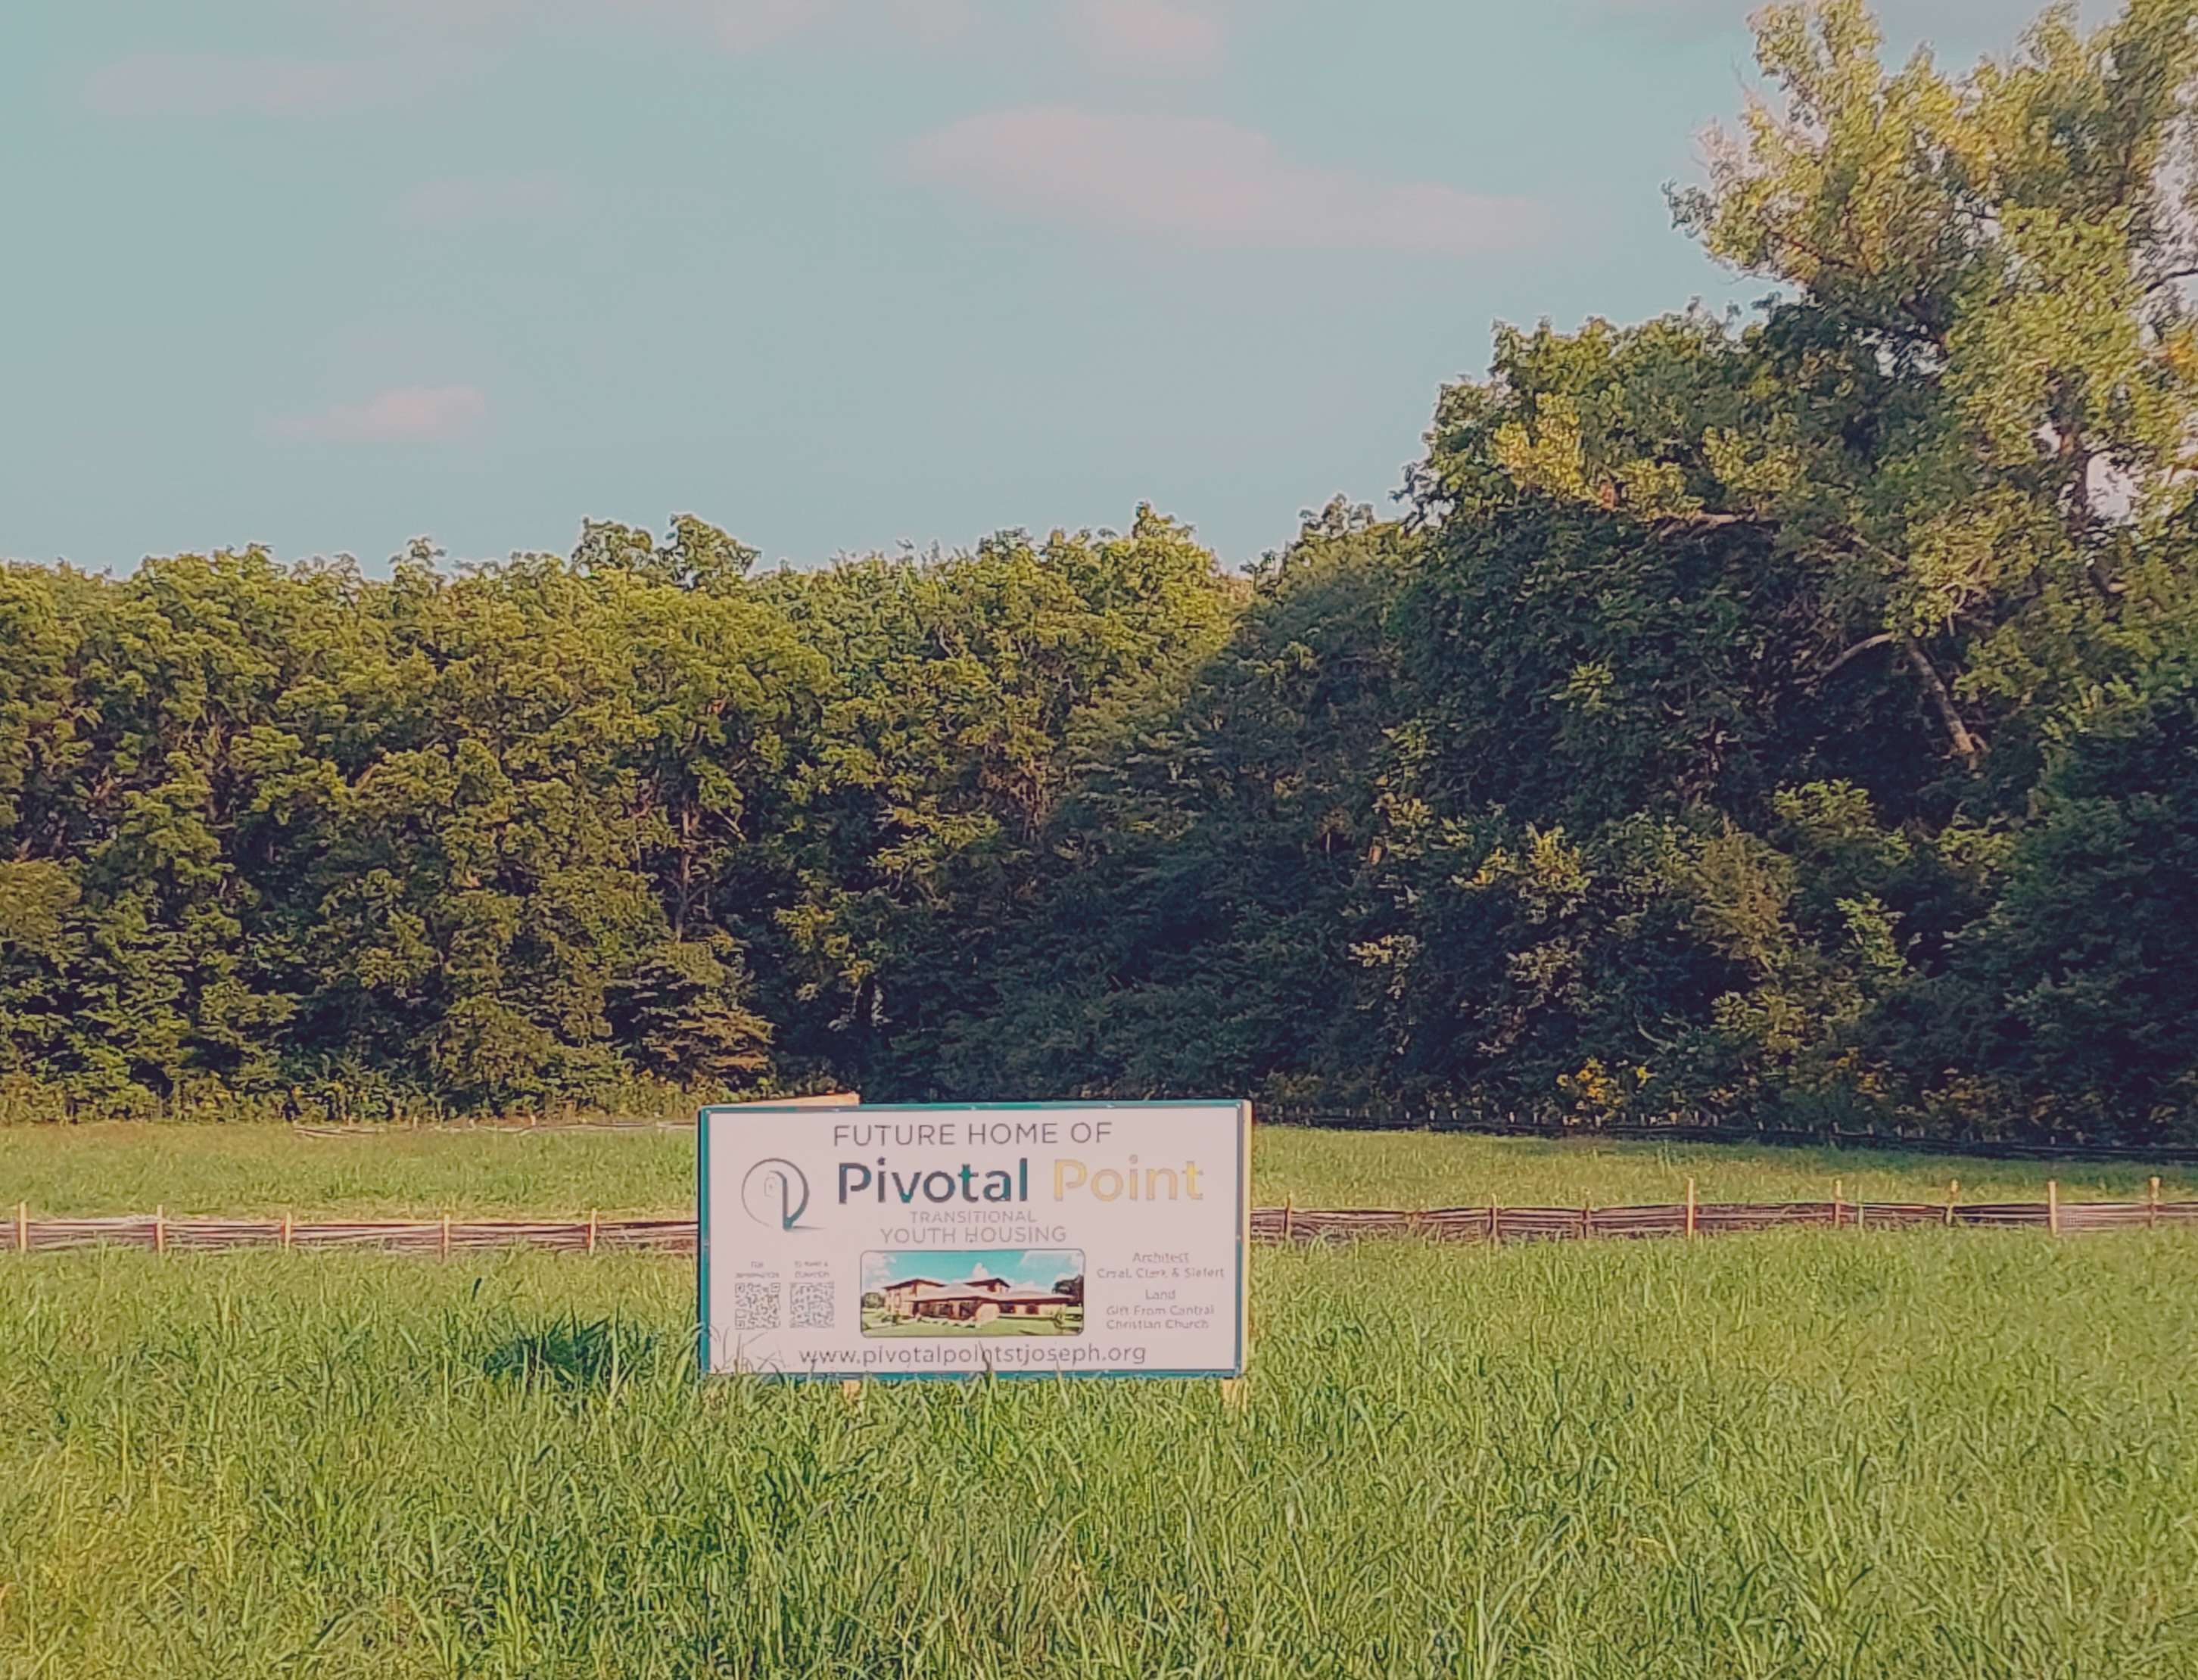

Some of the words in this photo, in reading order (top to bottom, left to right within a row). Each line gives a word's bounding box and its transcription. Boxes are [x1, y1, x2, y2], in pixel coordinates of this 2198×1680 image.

[833, 1123, 956, 1147] FUTURE
[968, 1122, 1059, 1146] HOME
[1069, 1121, 1113, 1144] OF
[838, 1157, 1029, 1205] Pivotal
[1054, 1154, 1204, 1202] Point
[910, 1210, 1037, 1224] TRANSITIONAL
[880, 1227, 957, 1245] YOUTH
[964, 1225, 1066, 1244] HOUSING
[1144, 1289, 1176, 1301] Land
[1134, 1305, 1166, 1316] From
[1165, 1319, 1210, 1330] Church
[799, 1343, 1147, 1364] www.pivotalpointstjoseph.org
